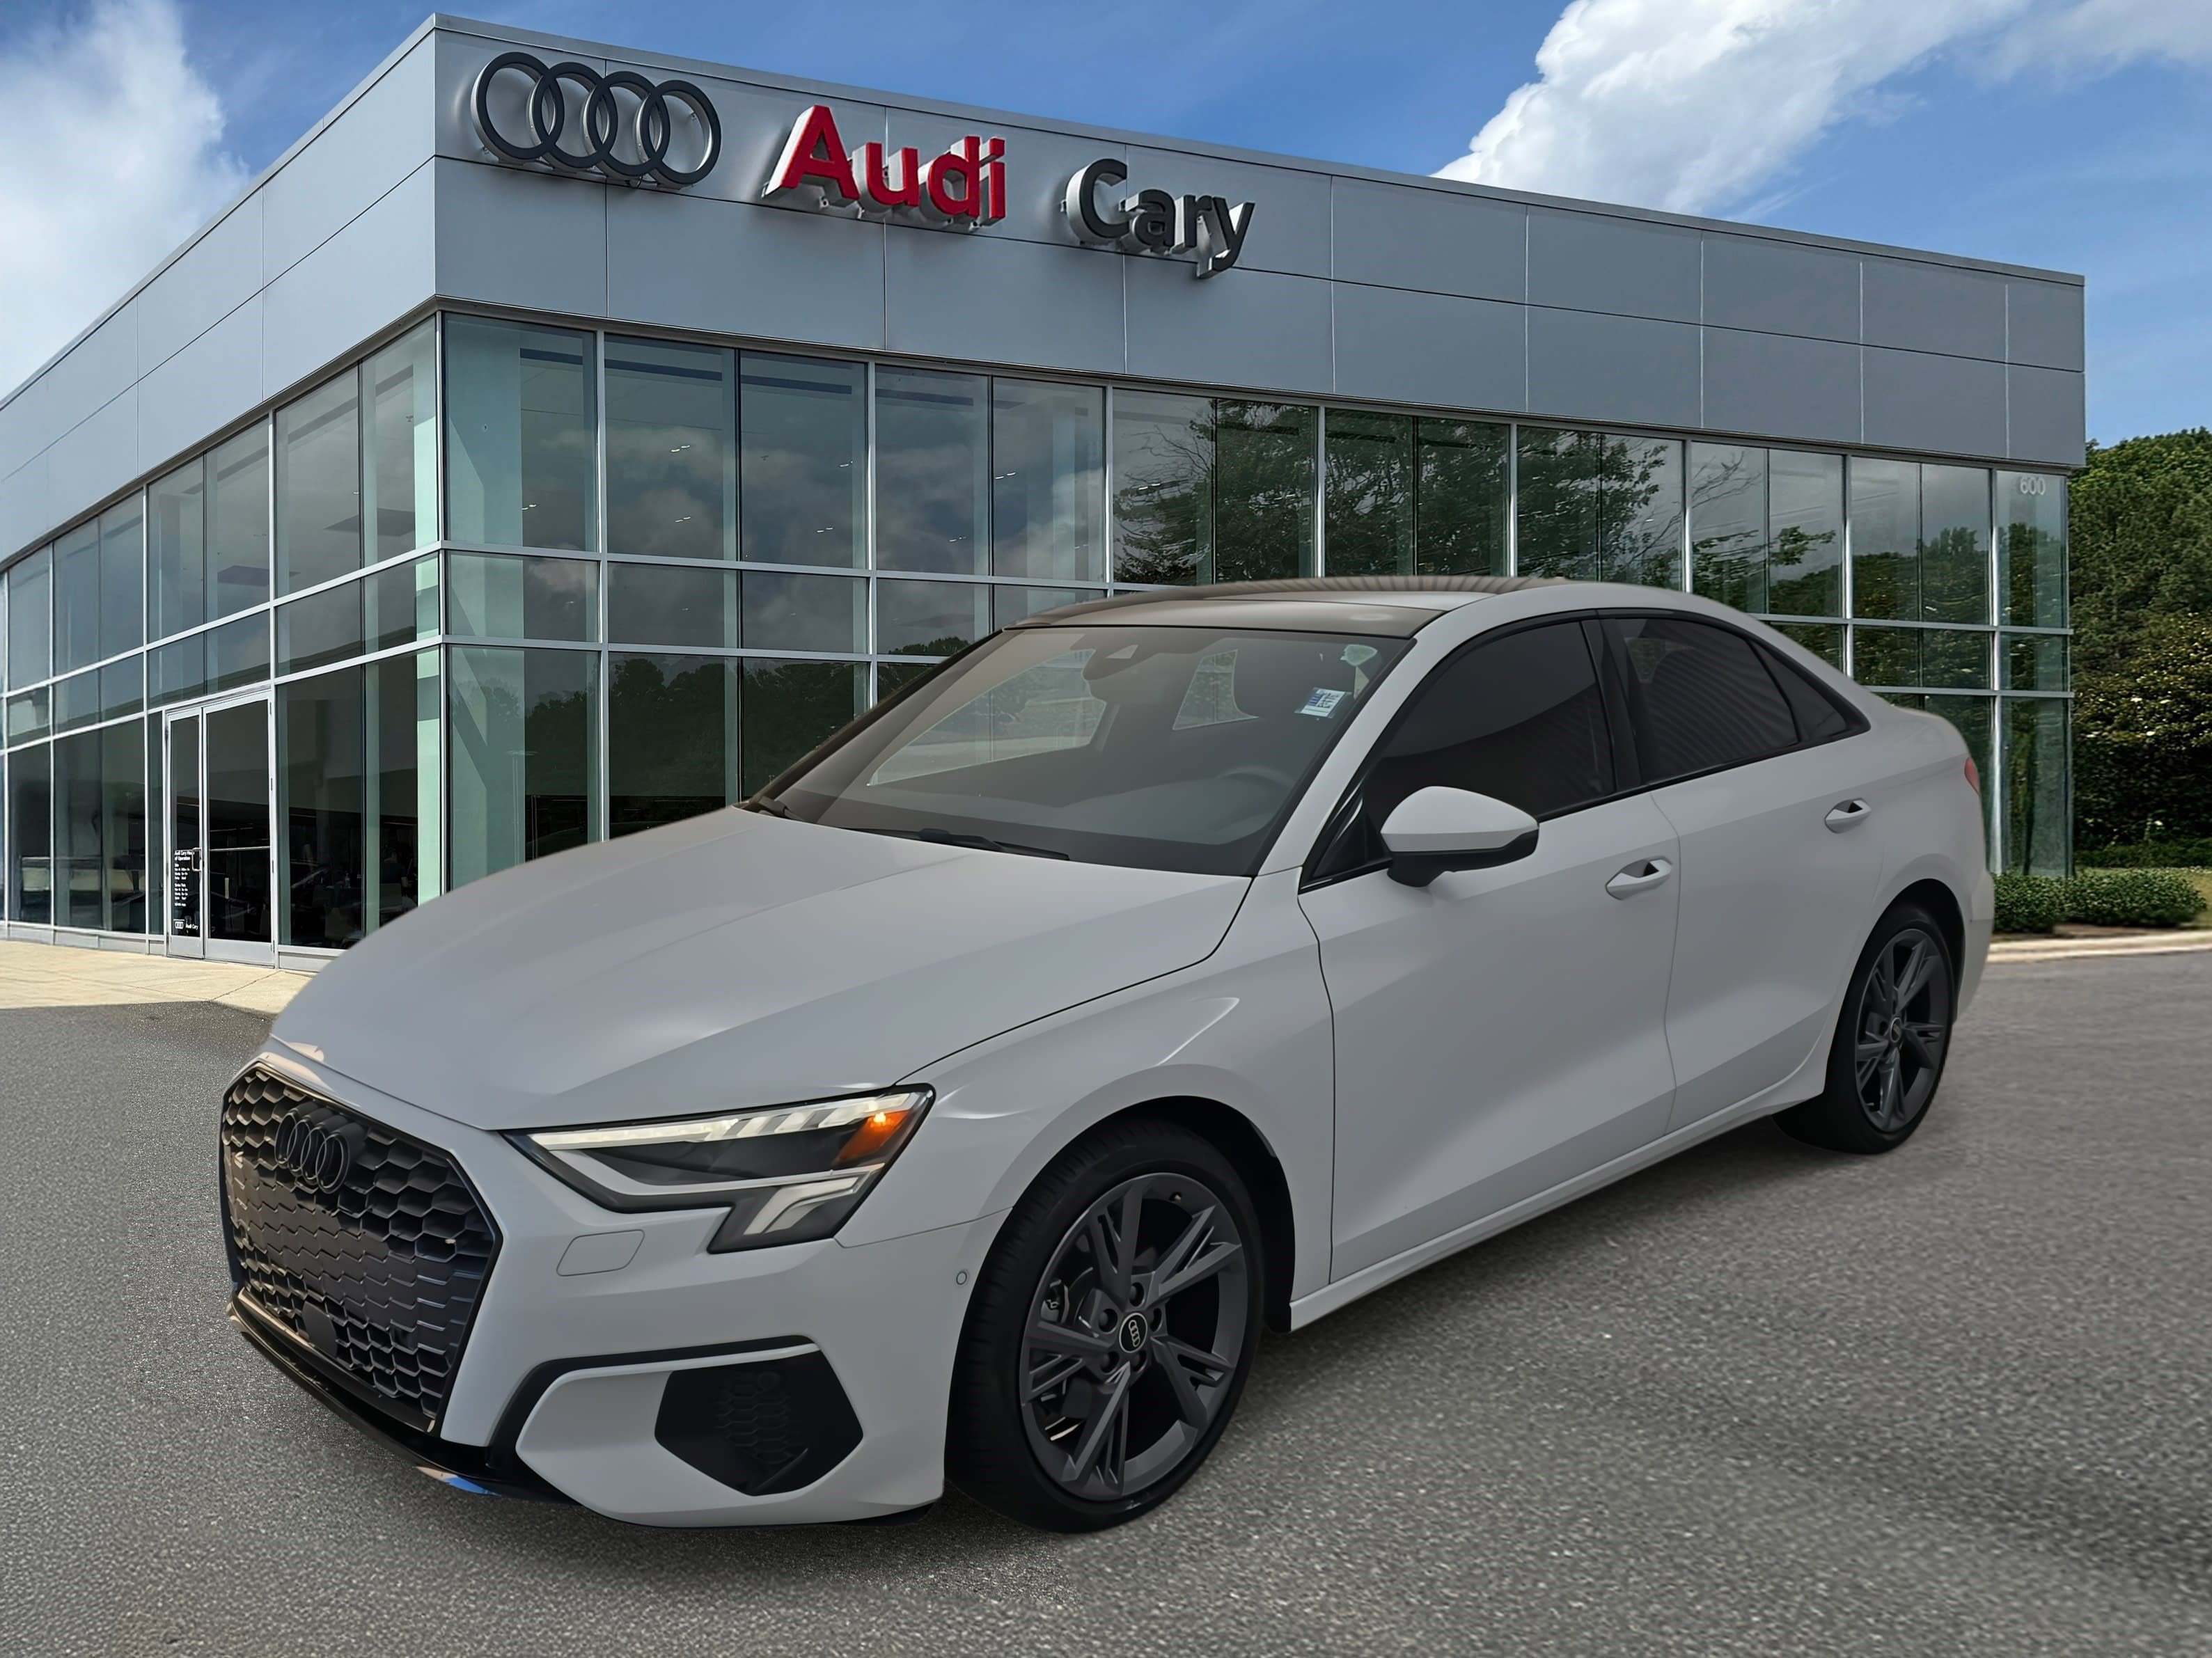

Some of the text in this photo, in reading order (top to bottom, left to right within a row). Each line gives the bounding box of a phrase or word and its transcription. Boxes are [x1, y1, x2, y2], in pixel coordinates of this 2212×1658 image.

[778, 104, 1255, 274] Audi Cary
[2021, 477, 2046, 495] 600
